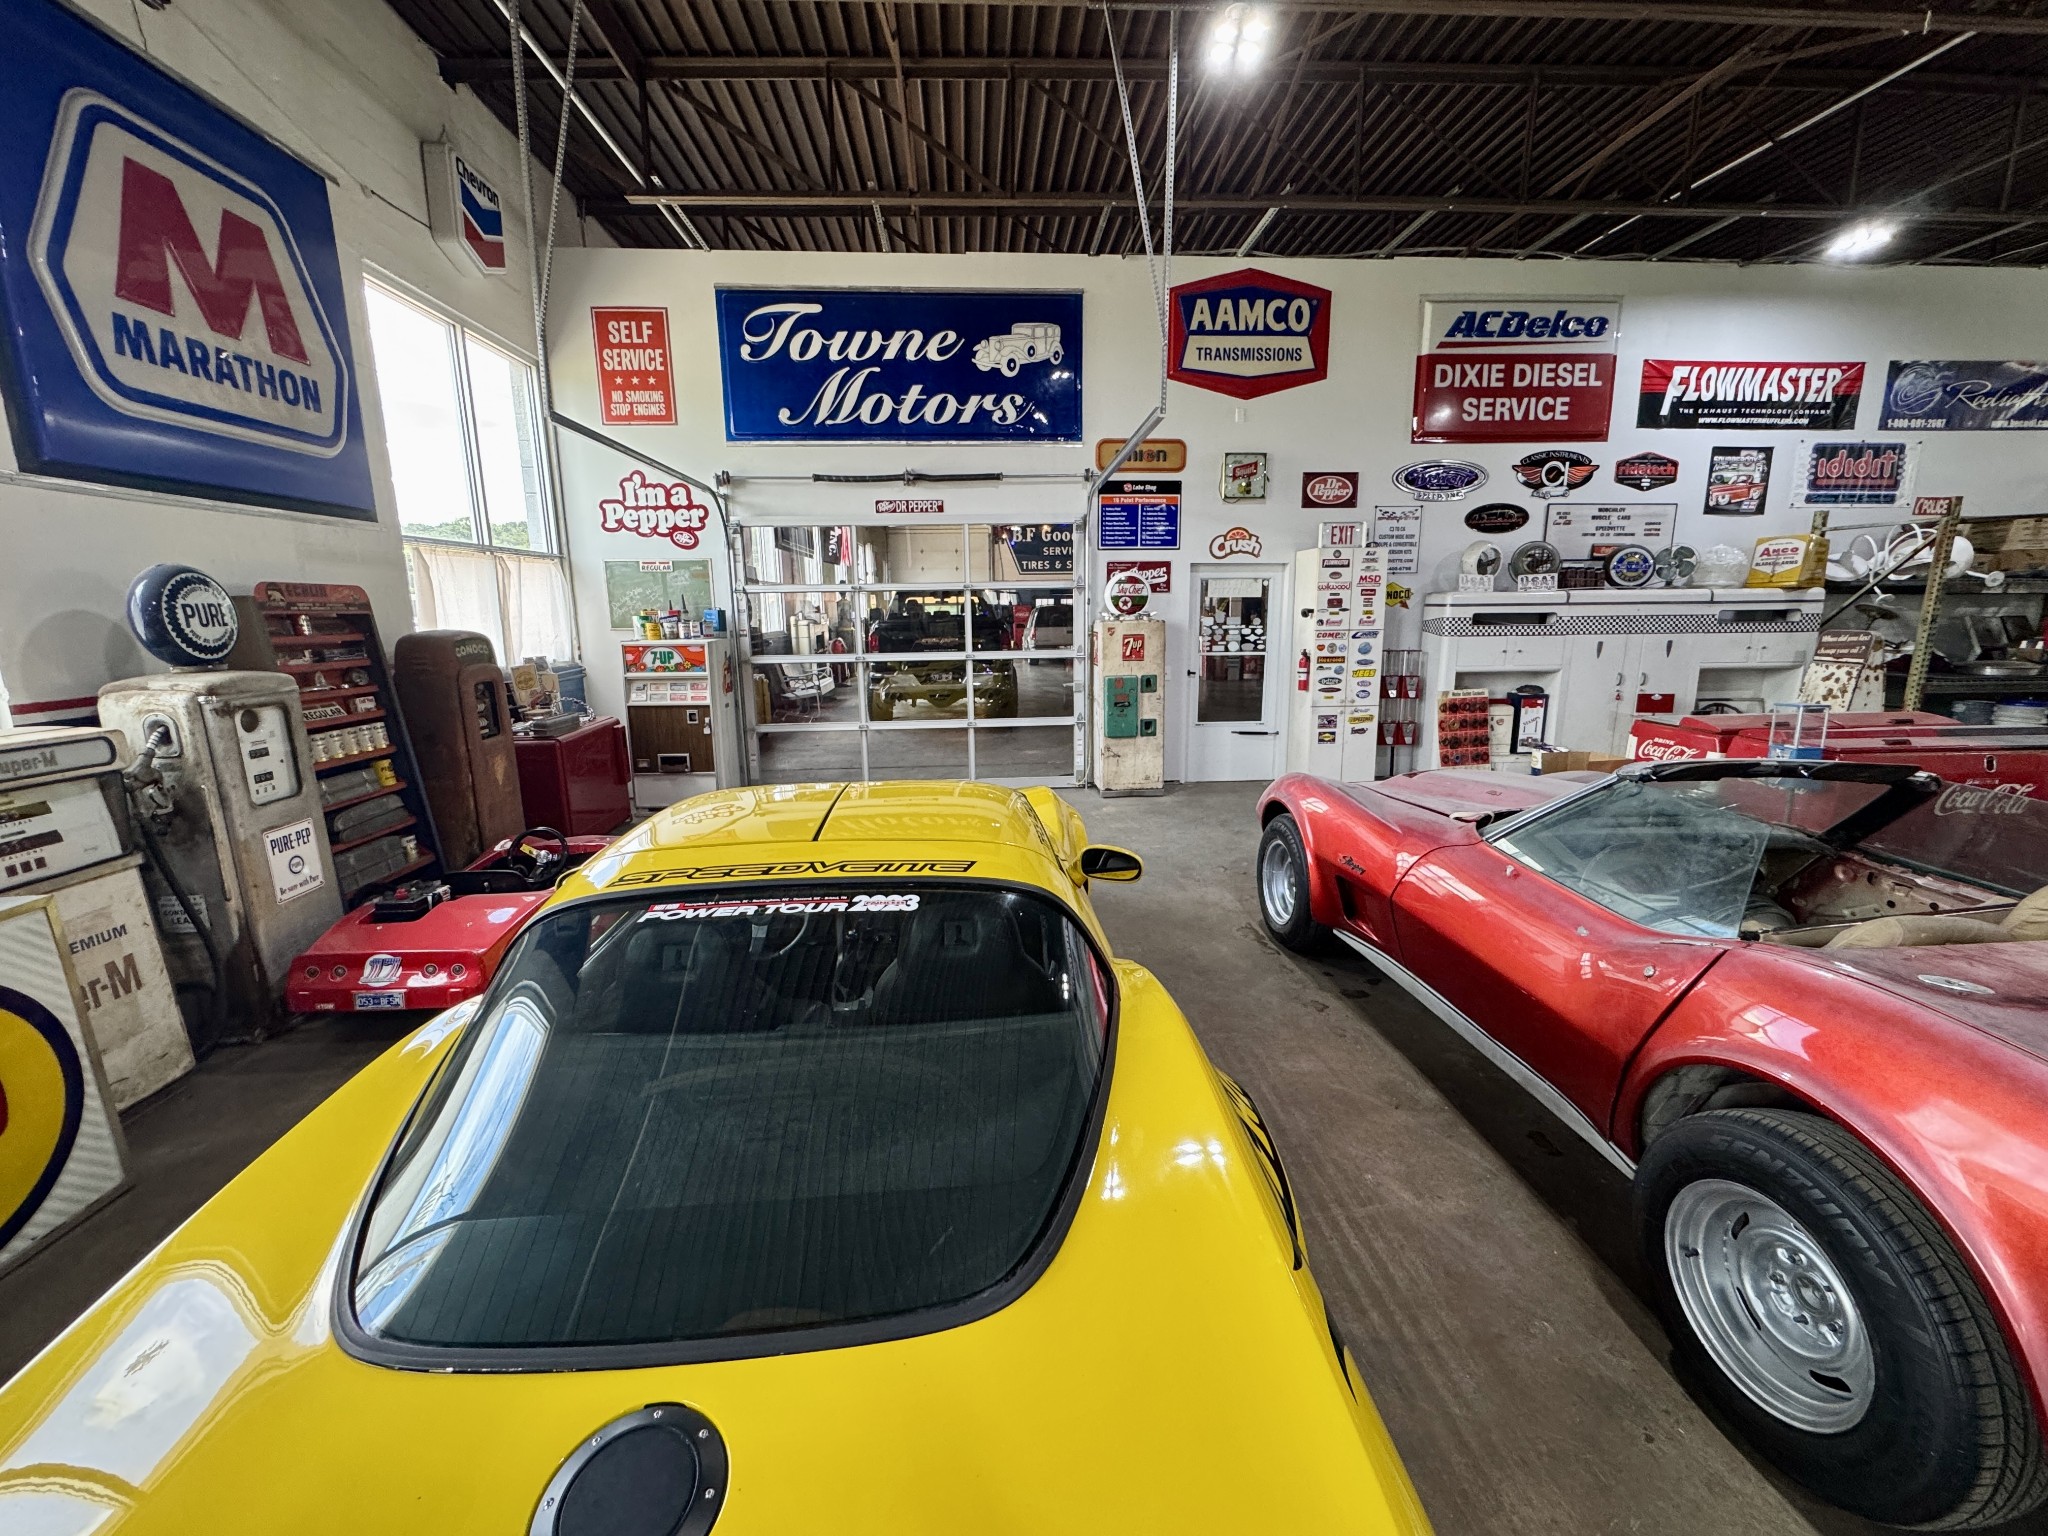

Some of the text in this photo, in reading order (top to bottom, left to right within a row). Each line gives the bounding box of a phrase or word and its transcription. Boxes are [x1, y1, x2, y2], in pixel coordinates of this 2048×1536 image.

[456, 156, 499, 209] Chevron
[1189, 298, 1310, 332] AAMCO
[1444, 310, 1609, 338] ACDelco
[608, 321, 652, 343] SELF
[740, 303, 965, 361] Towne
[113, 312, 322, 414] MARATHON
[603, 349, 664, 371] SERVICE
[1196, 347, 1302, 362] TRANSMISSIONS
[1434, 363, 1603, 388] DIXIE DIESEL
[611, 391, 664, 402] NO SMOKING
[778, 367, 1032, 427] Motors
[1659, 366, 1843, 416] FLOWMASTER
[611, 404, 666, 416] STOP ENGINES
[1462, 397, 1570, 422] SERVICE
[1522, 451, 1590, 465] CLASSIC INSTRUMENTS
[622, 474, 690, 507] I'm a
[1313, 483, 1350, 500] Pepper
[1326, 478, 1343, 488] Dr
[896, 501, 938, 512] DR PEPPER
[1920, 499, 1949, 514] POLICE
[602, 503, 705, 534] Pepper
[1012, 526, 1035, 543] B.F
[1331, 526, 1355, 545] EXIT
[1043, 546, 1073, 556] SERVI
[1211, 535, 1261, 558] Crush
[1022, 560, 1050, 570] TIRES
[1055, 561, 1062, 570] &
[1359, 575, 1382, 583] MSD
[181, 602, 229, 628] PURE
[1821, 634, 1838, 642] When
[456, 644, 489, 657] CONOCO
[303, 706, 344, 721] REGULAR
[1653, 737, 1676, 746] DRINK
[270, 827, 311, 856] PURE-PEP
[299, 876, 309, 889] with
[609, 860, 977, 888] SPEEDVETTE
[637, 894, 921, 923] POWER TOUR 2023
